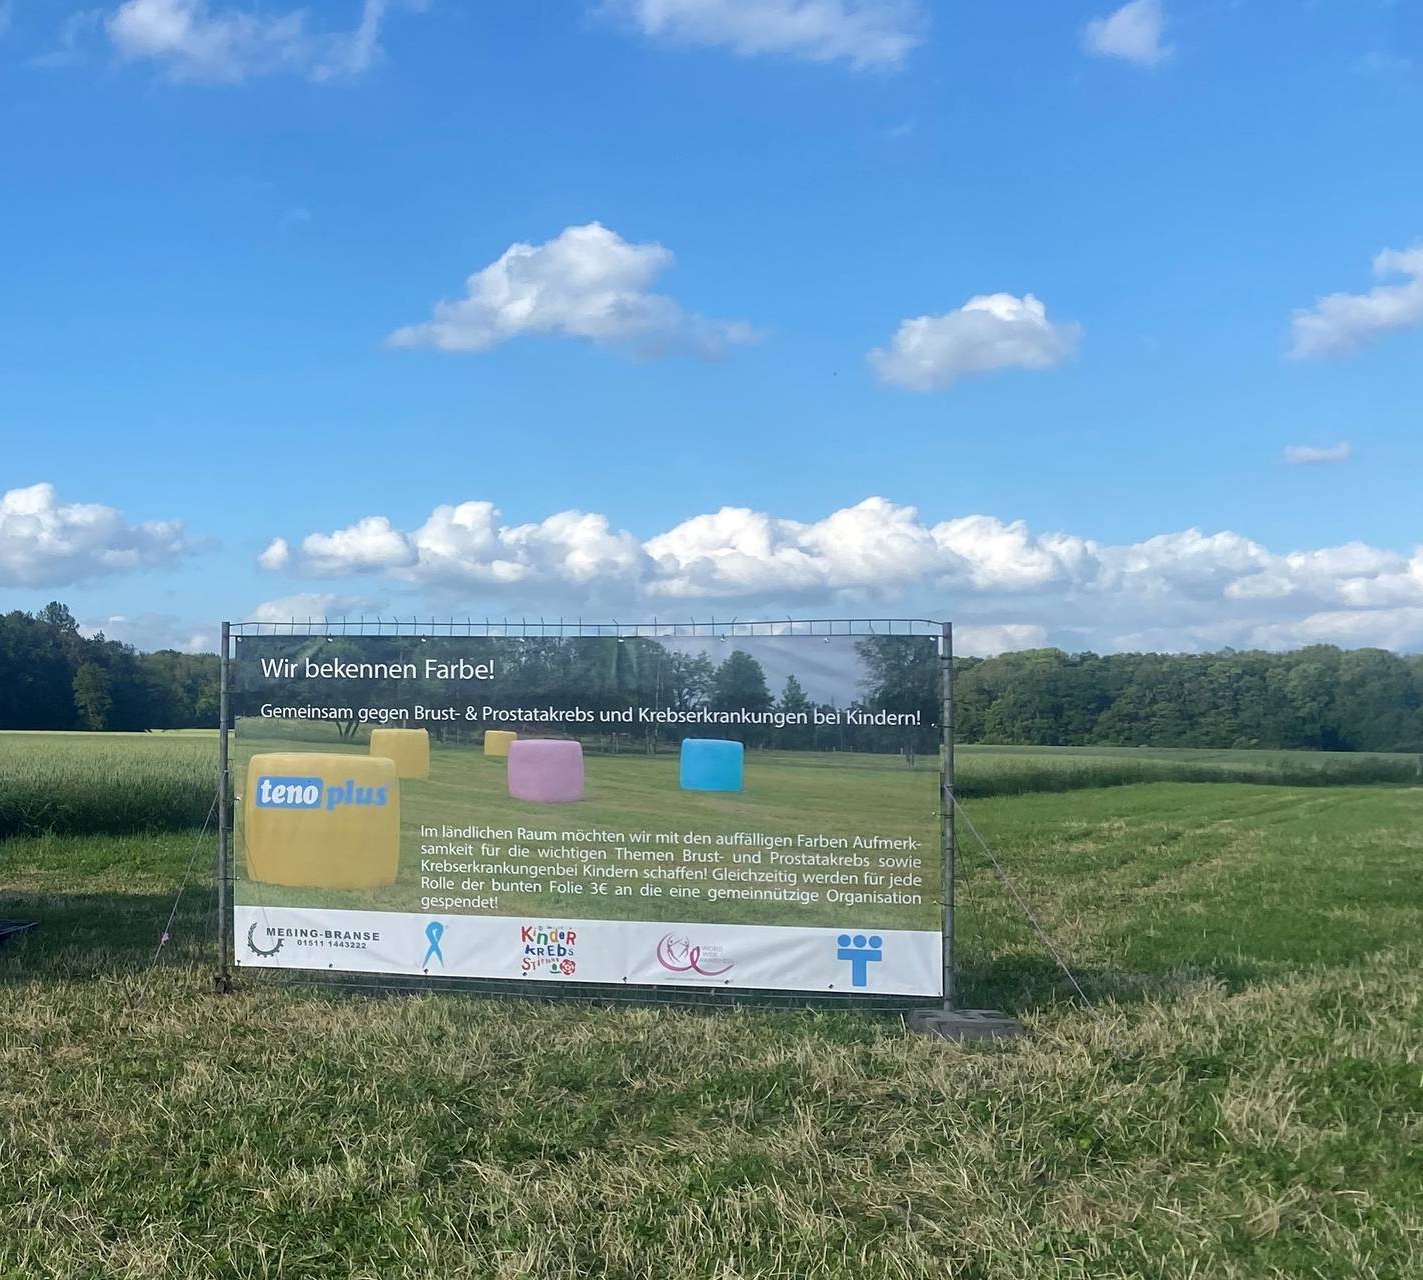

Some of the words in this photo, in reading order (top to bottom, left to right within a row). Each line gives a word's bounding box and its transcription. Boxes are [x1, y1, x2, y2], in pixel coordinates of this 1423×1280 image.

[260, 658, 298, 678] Wir
[305, 658, 416, 679] bekennen
[425, 659, 495, 680] Farbe!
[260, 704, 353, 719] Gemeinsam
[358, 708, 409, 724] gegen
[414, 706, 461, 721] Brust-
[465, 707, 477, 721] &
[482, 706, 594, 722] Prostatakrebs
[600, 707, 632, 722] und
[639, 707, 807, 728] Krebserkrankungen
[814, 709, 840, 725] bei
[847, 710, 921, 726] Kindern!
[261, 779, 319, 804] teno
[326, 779, 387, 811] plus
[421, 826, 437, 837] Im
[442, 825, 513, 840] ländlichen
[518, 828, 557, 841] Raum
[562, 829, 625, 843] möchten
[629, 831, 651, 843] wir
[656, 832, 679, 844] mit
[683, 832, 711, 844] den
[716, 832, 792, 849] auffälligen
[797, 834, 848, 848] Farben
[853, 835, 921, 850] Aufmerk-
[421, 843, 473, 856] samkeit
[481, 844, 500, 856] für
[508, 845, 530, 858] die
[538, 846, 607, 862] wichtigen
[615, 847, 674, 861] Themen
[683, 850, 724, 863] Brust-
[732, 851, 761, 864] und
[770, 852, 870, 867] Prostatakrebs
[879, 855, 921, 868] sowie
[421, 860, 577, 878] Krebserkrankungenbei
[583, 865, 638, 878] Kindern
[643, 866, 707, 880] schaffen!
[712, 867, 797, 885] Gleichzeitig
[802, 871, 858, 885] werden
[864, 872, 885, 885] für
[888, 872, 921, 888] jede
[421, 877, 454, 890] Rolle
[462, 878, 485, 890] der
[492, 879, 542, 893] bunten
[550, 881, 583, 894] Folie
[590, 883, 608, 895] 3€
[615, 885, 632, 896] an
[640, 883, 662, 896] die
[669, 885, 700, 898] eine
[708, 887, 819, 905] gemeinnützige
[827, 889, 921, 905] Organisation
[421, 896, 498, 909] gespendet!
[297, 939, 324, 947] 01511
[328, 941, 366, 949] 1443222
